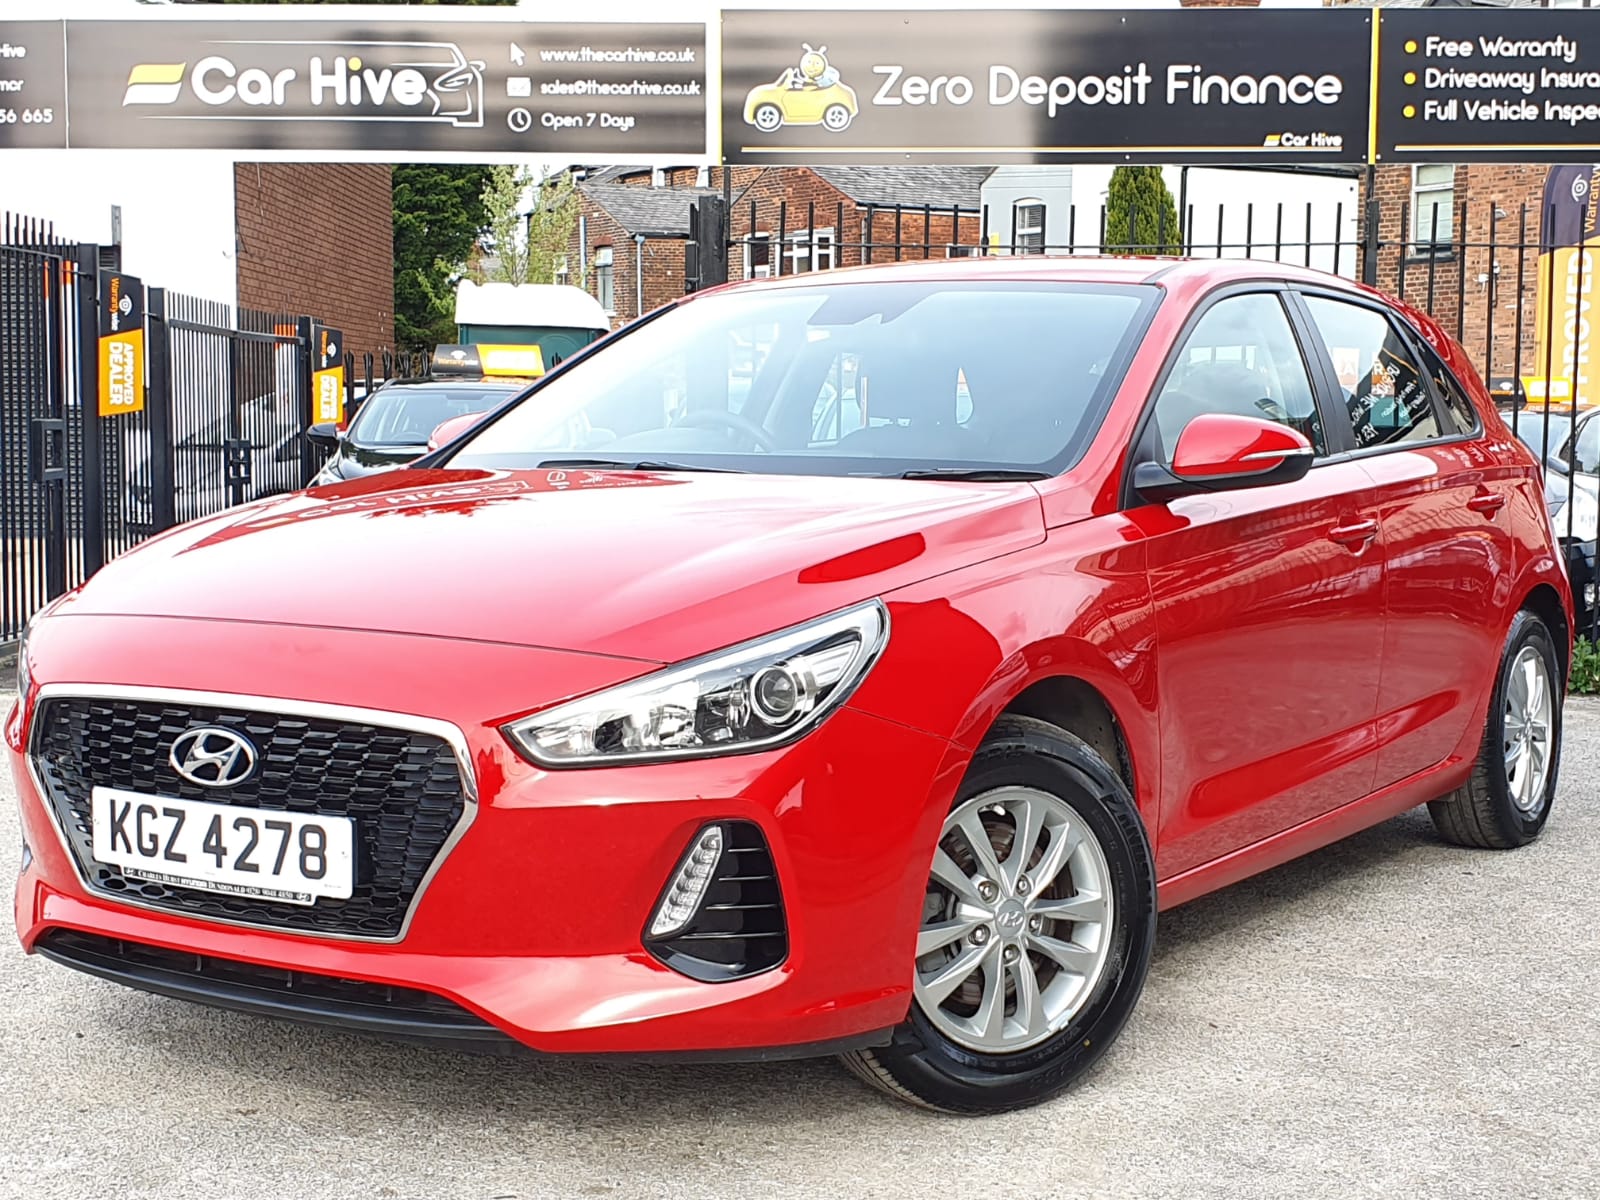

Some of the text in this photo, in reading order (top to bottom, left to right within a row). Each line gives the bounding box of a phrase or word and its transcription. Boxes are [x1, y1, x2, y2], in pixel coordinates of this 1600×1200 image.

[540, 47, 695, 63] www.thecarhive.co.uk
[1425, 35, 1577, 62] Free Warranty
[191, 56, 427, 105] Car Hive
[540, 81, 700, 96] sales@thecarhive.co.uk
[872, 63, 1343, 117] Zero Deposit Finance
[1424, 67, 1600, 95] Driveaway Insura
[22, 108, 53, 124] 665
[541, 113, 635, 131] Open 7 Days
[1424, 99, 1600, 126] Full Vehicle Inspe
[1281, 132, 1342, 146] Car Hive
[109, 277, 120, 331] Warrantywise
[109, 341, 123, 405] DEALER
[124, 342, 135, 405] APPROVED
[110, 799, 327, 880] KGZ 4278
